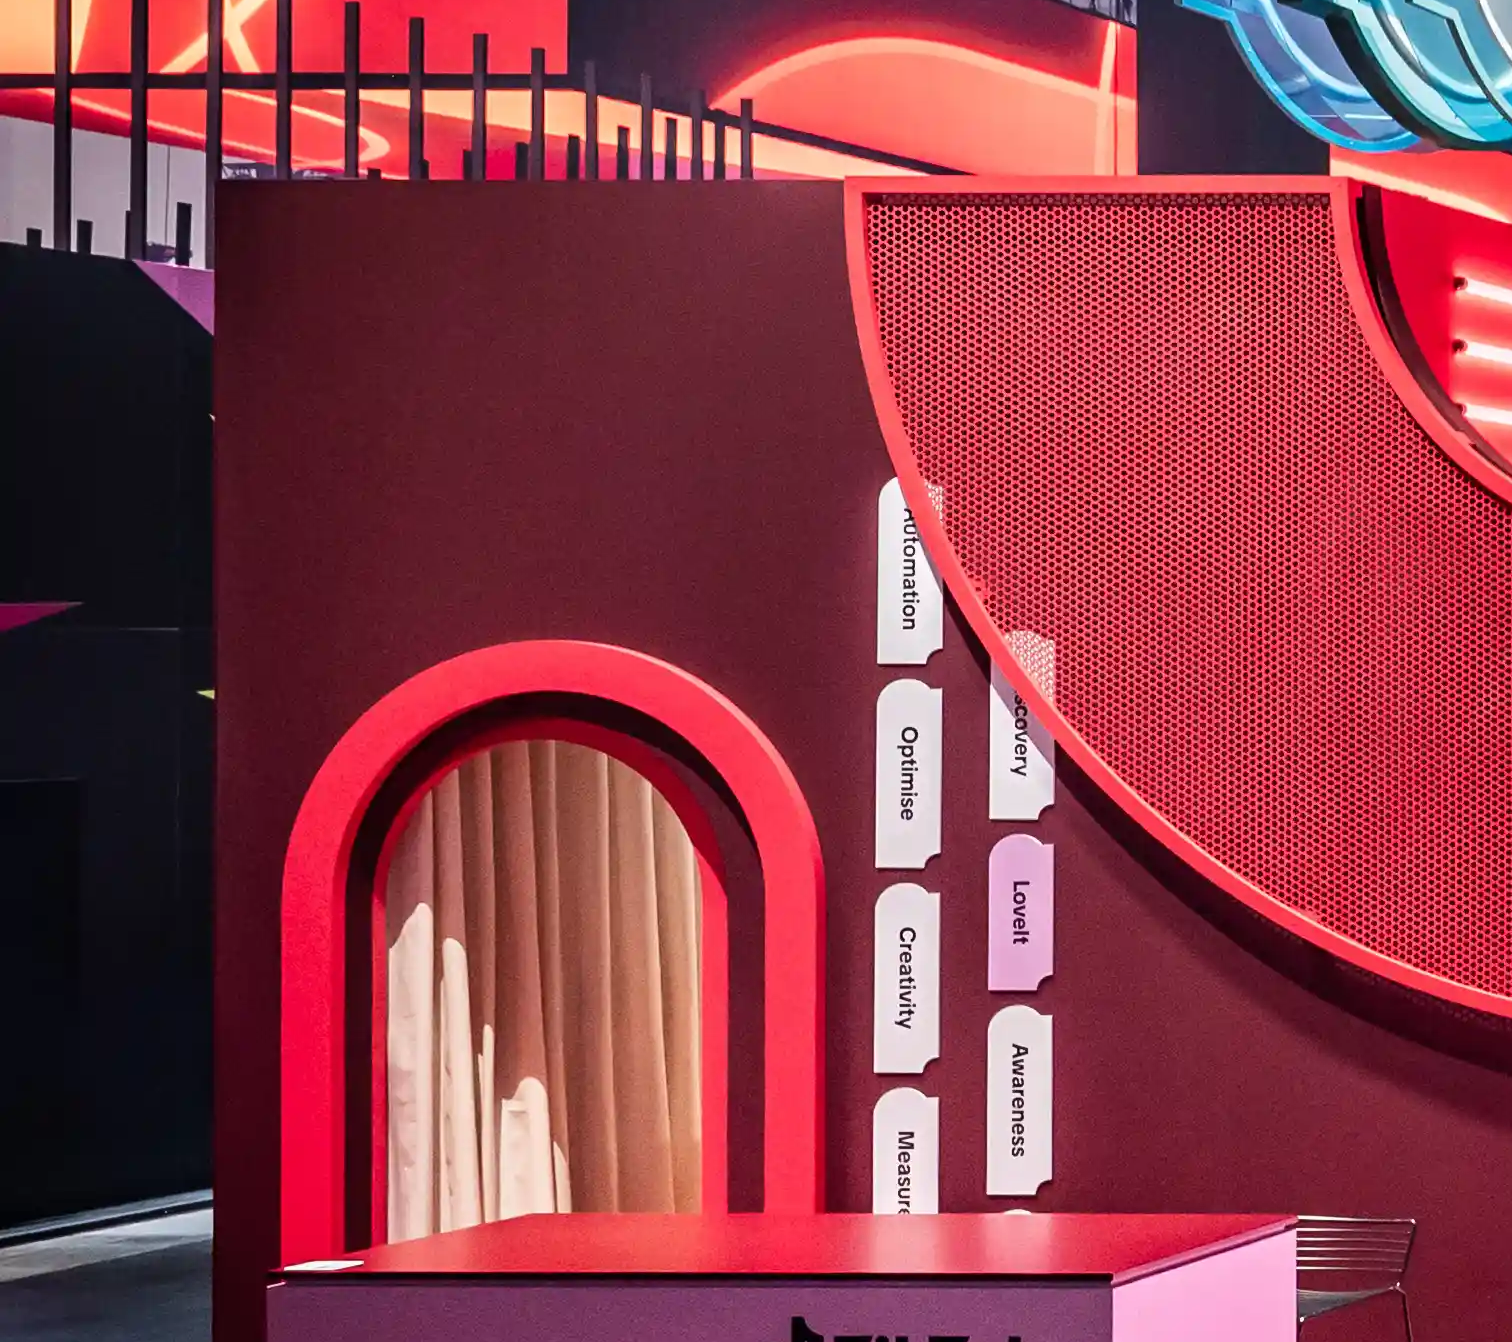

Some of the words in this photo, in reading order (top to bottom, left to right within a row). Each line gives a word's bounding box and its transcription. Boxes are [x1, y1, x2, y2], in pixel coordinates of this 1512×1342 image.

[896, 726, 919, 821] Optimise
[1013, 880, 1031, 945] LoveIt
[895, 926, 917, 1030] Creativity
[1011, 1043, 1029, 1157] Awareness
